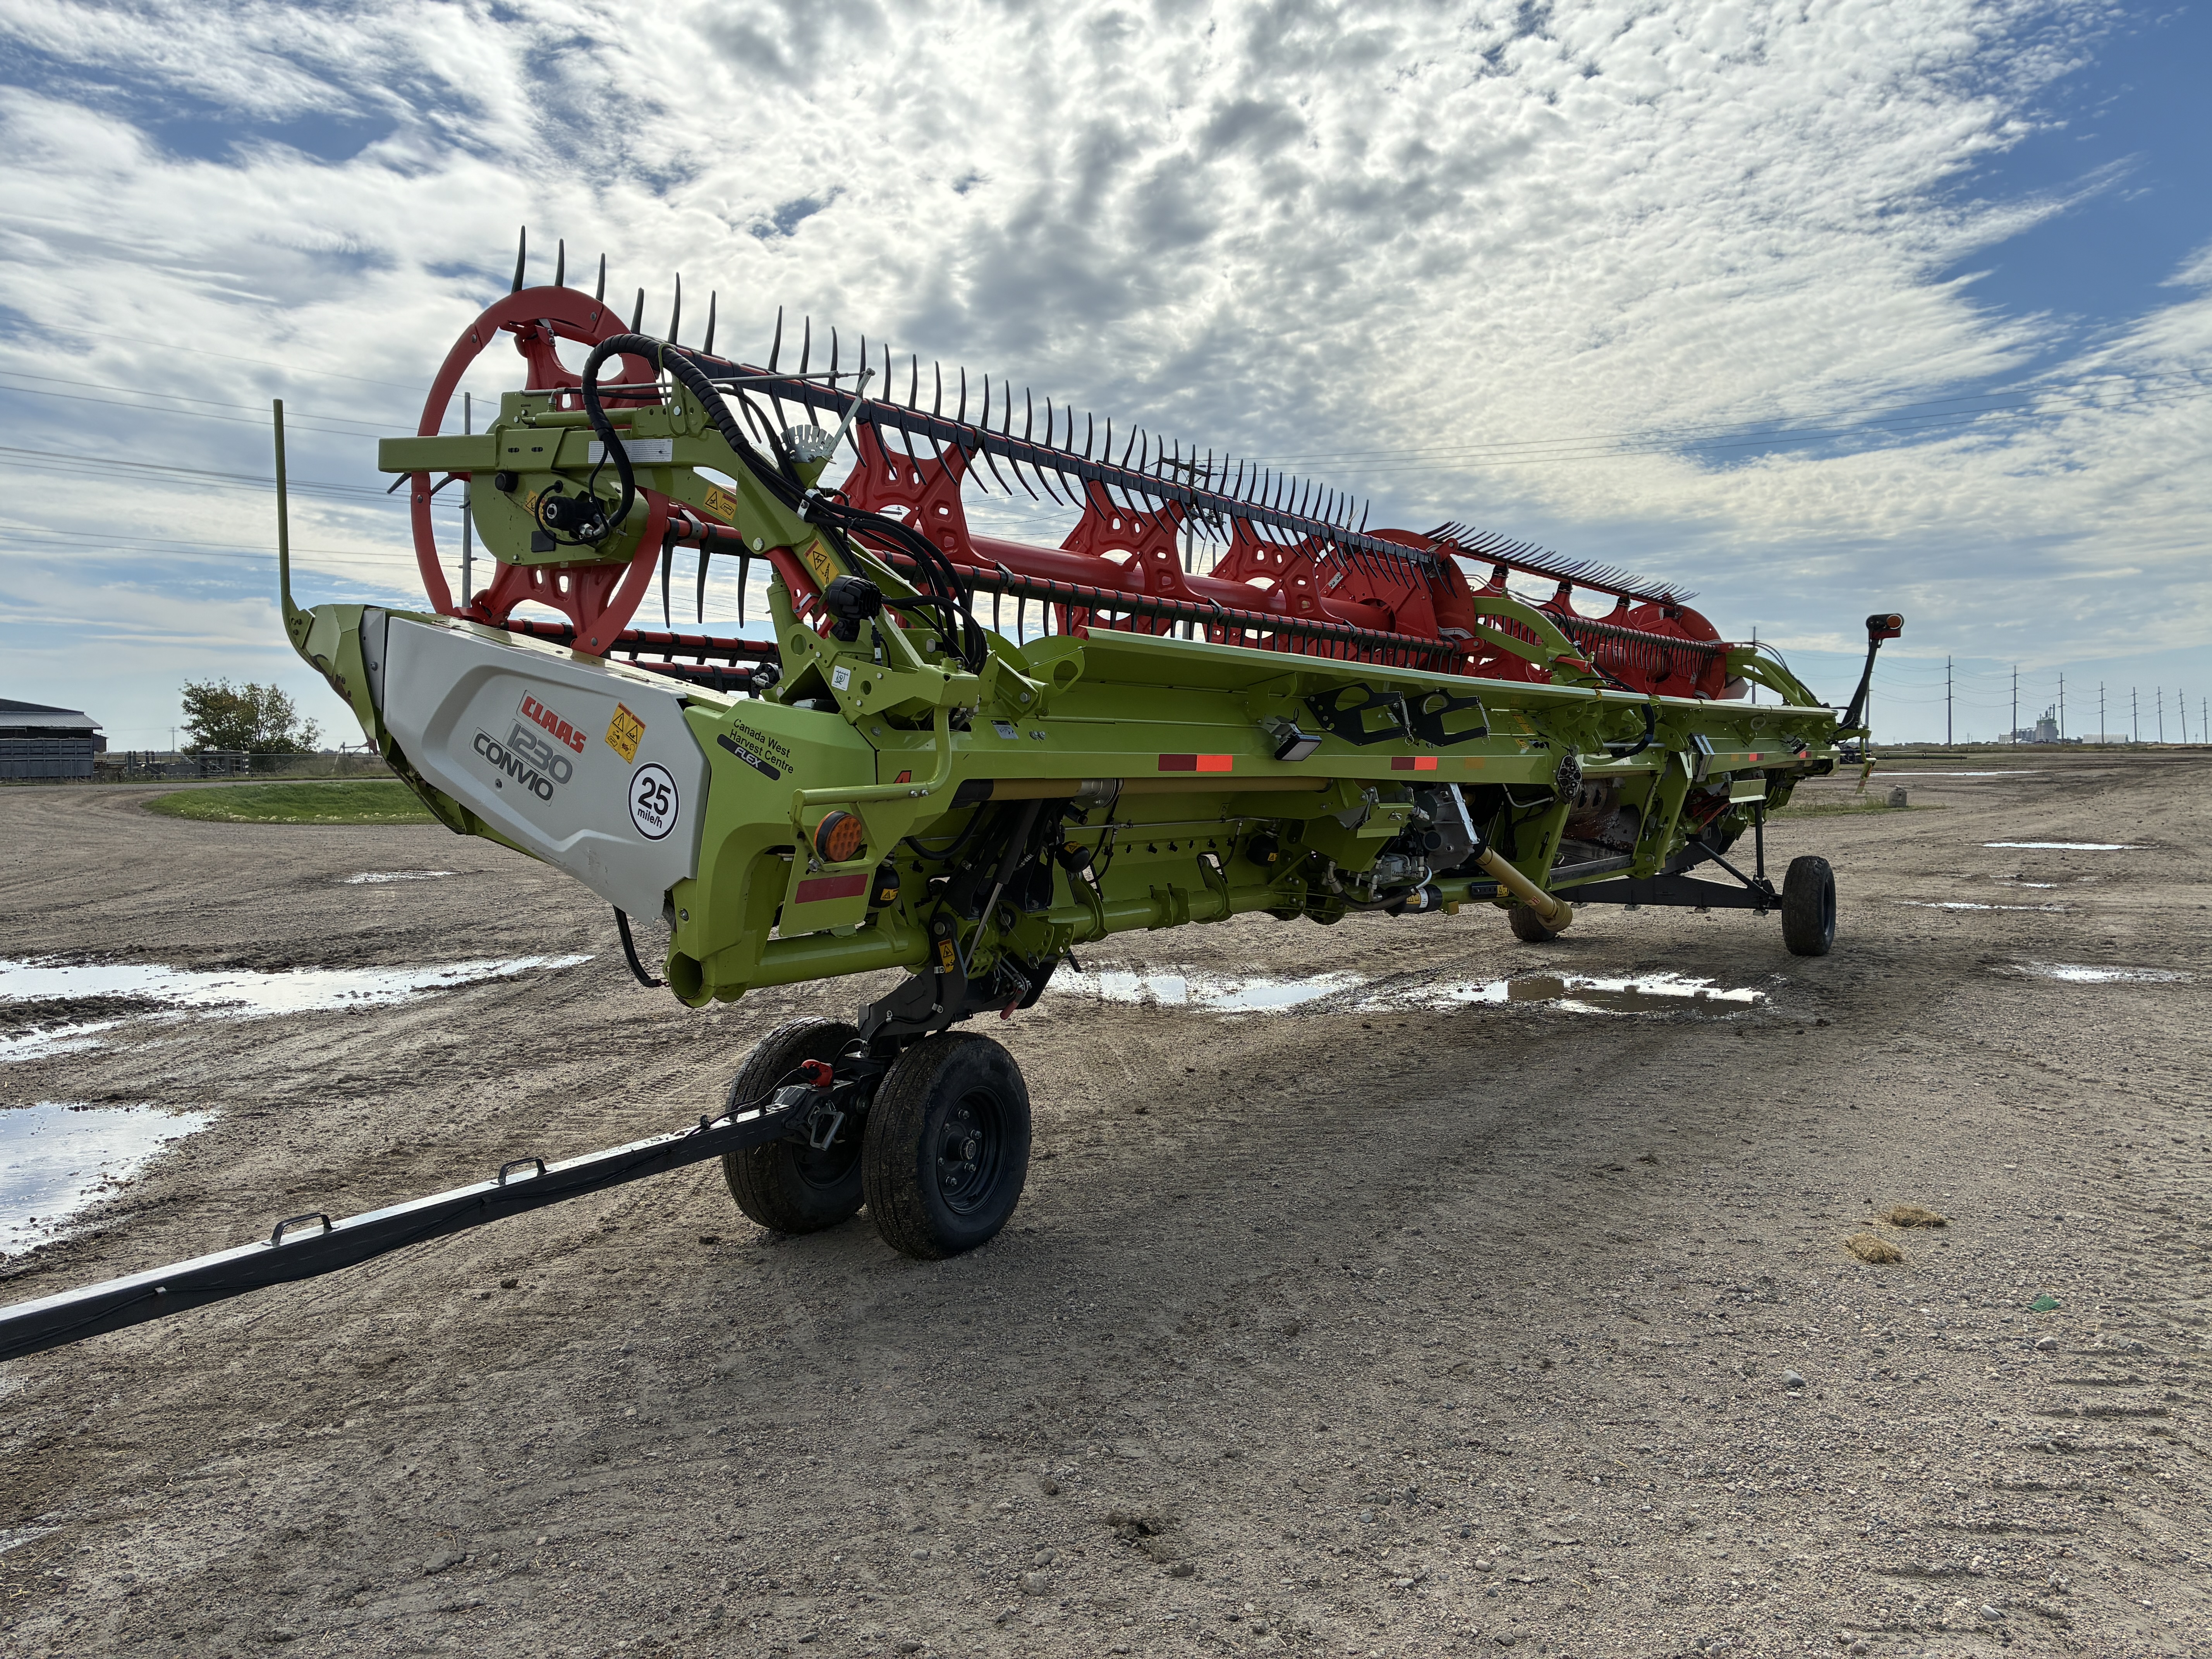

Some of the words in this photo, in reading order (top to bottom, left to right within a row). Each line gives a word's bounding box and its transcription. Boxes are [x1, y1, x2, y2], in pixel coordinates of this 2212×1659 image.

[521, 696, 587, 754] CLAAS
[733, 718, 766, 744] Canada
[768, 737, 791, 758] West
[474, 733, 554, 801] CONVIO
[507, 723, 573, 784] 1230
[730, 728, 763, 756] Harvest
[764, 750, 793, 774] Centre
[734, 747, 762, 768] FLEX
[638, 777, 671, 816] 25
[637, 808, 662, 829] mile/h
